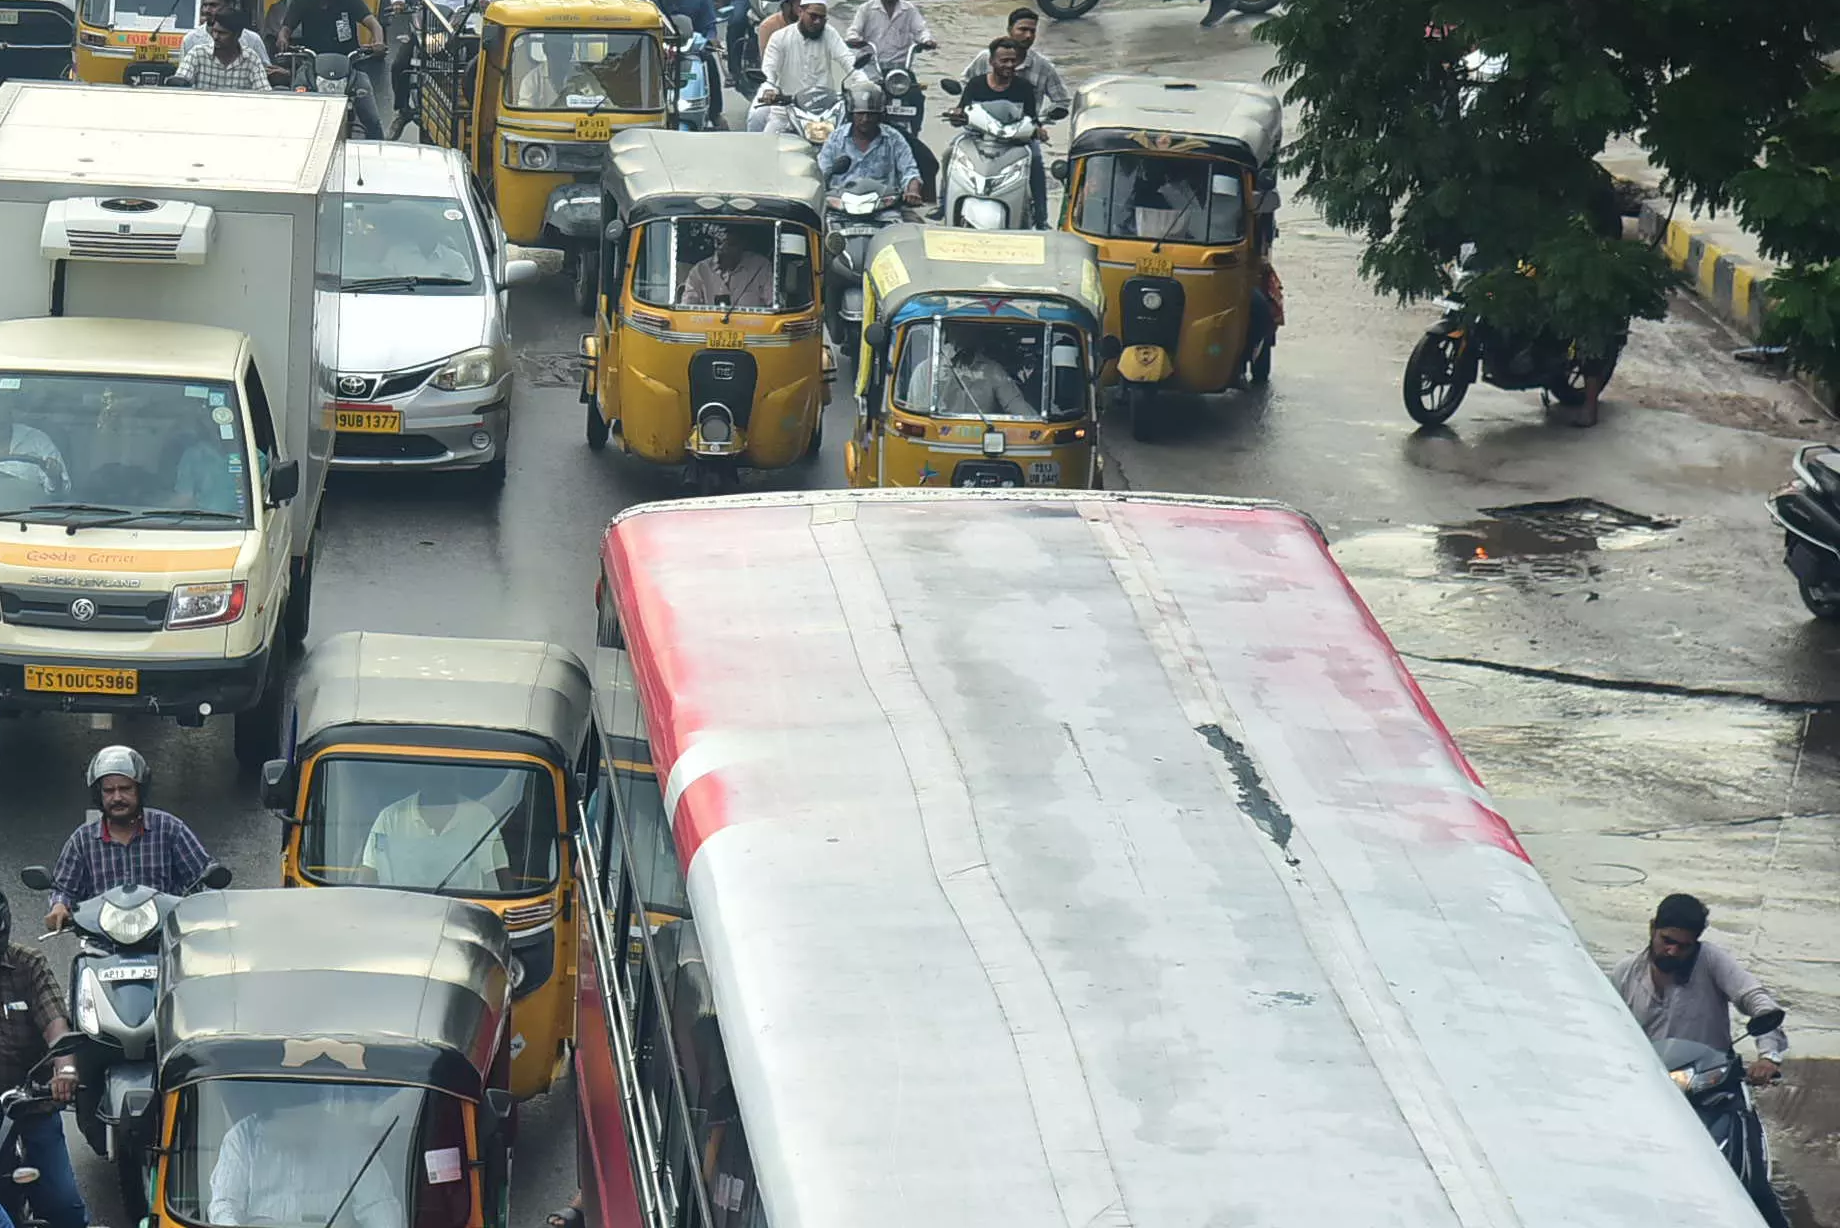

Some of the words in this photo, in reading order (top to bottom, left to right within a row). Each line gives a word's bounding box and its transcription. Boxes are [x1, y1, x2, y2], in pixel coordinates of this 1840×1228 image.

[128, 34, 148, 44] FOR
[27, 550, 76, 563] Goods
[88, 553, 137, 564] Carrier
[28, 574, 77, 586] ASHOK
[79, 576, 142, 588] LEYLAND
[35, 671, 134, 690] TS10UC5986
